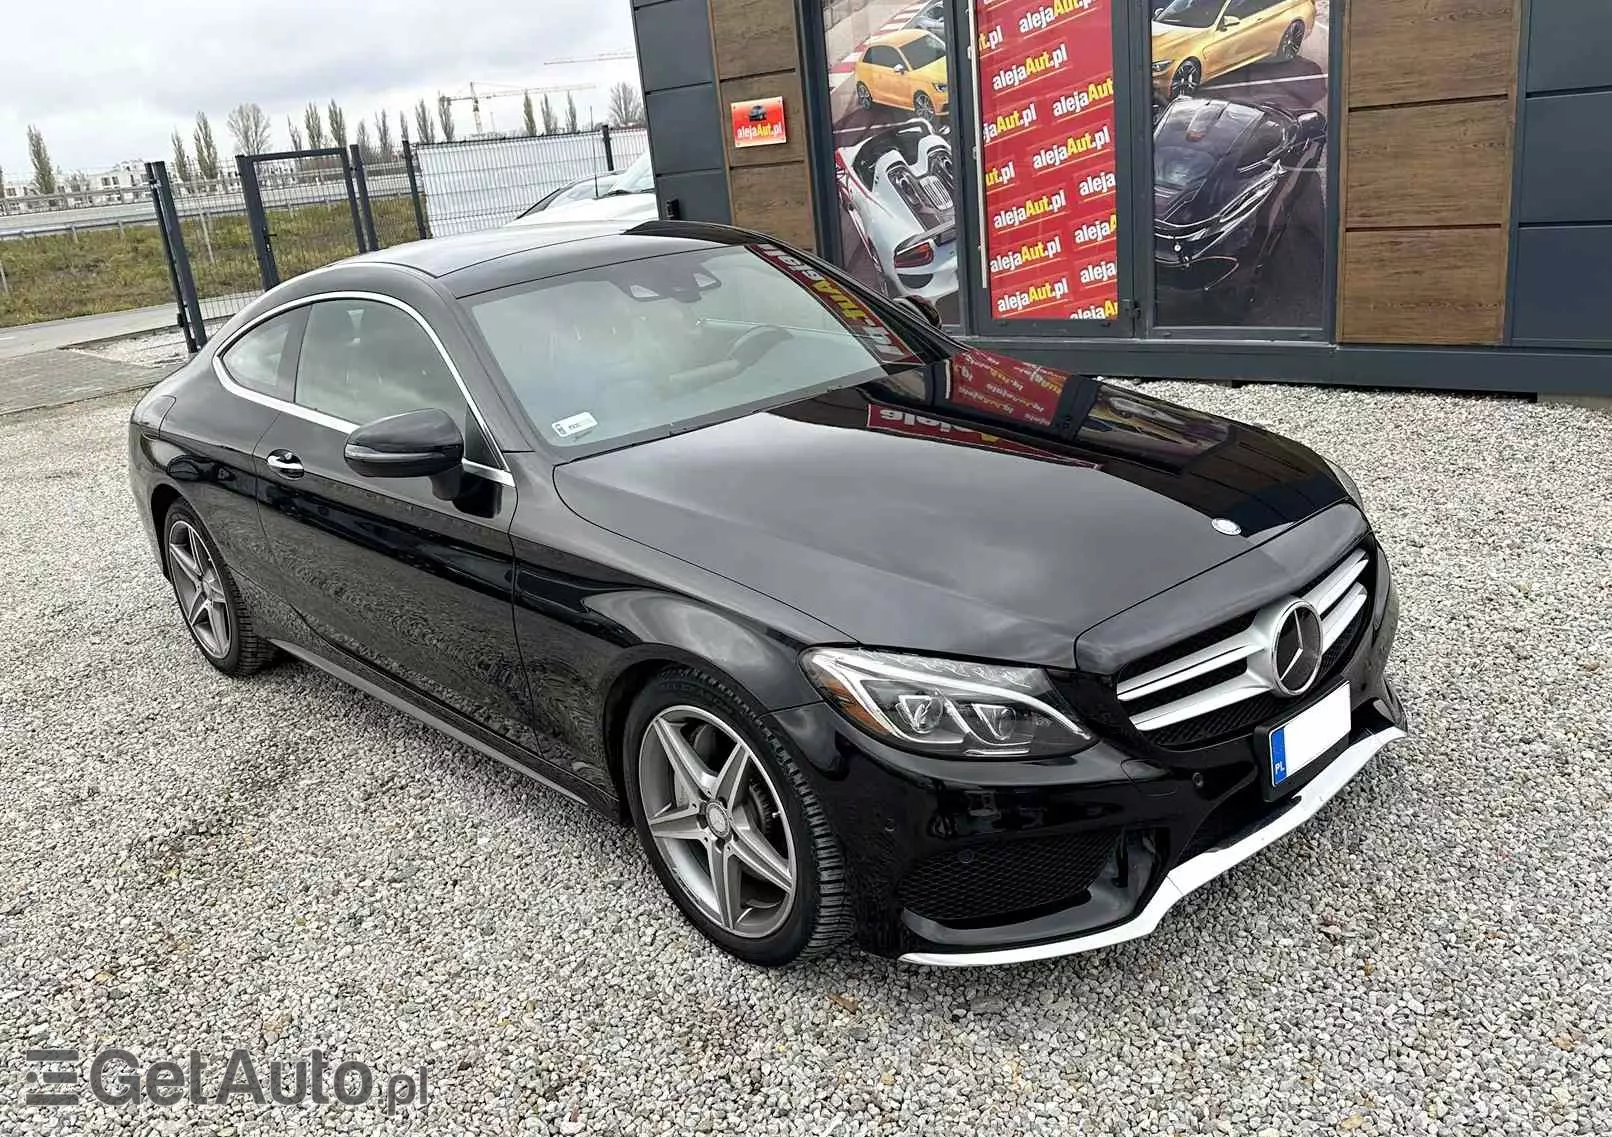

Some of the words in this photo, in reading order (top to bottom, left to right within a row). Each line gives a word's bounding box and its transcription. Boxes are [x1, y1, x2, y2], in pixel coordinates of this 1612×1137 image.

[1019, 0, 1096, 33] alejaAut.p
[979, 25, 1004, 51] t.pl
[992, 43, 1069, 90] alejaAut.pl
[737, 122, 783, 140] alejaAut.pl
[984, 103, 1038, 142] jaAut.pl
[1032, 125, 1111, 169] alejaAut.pl
[1079, 172, 1117, 197] aleja
[993, 189, 1067, 229] alejaAut.pl
[990, 236, 1061, 273] alejaAut.pl
[1080, 261, 1117, 284] aleja
[996, 278, 1069, 312] alejaAut.pl
[1275, 761, 1285, 775] PL
